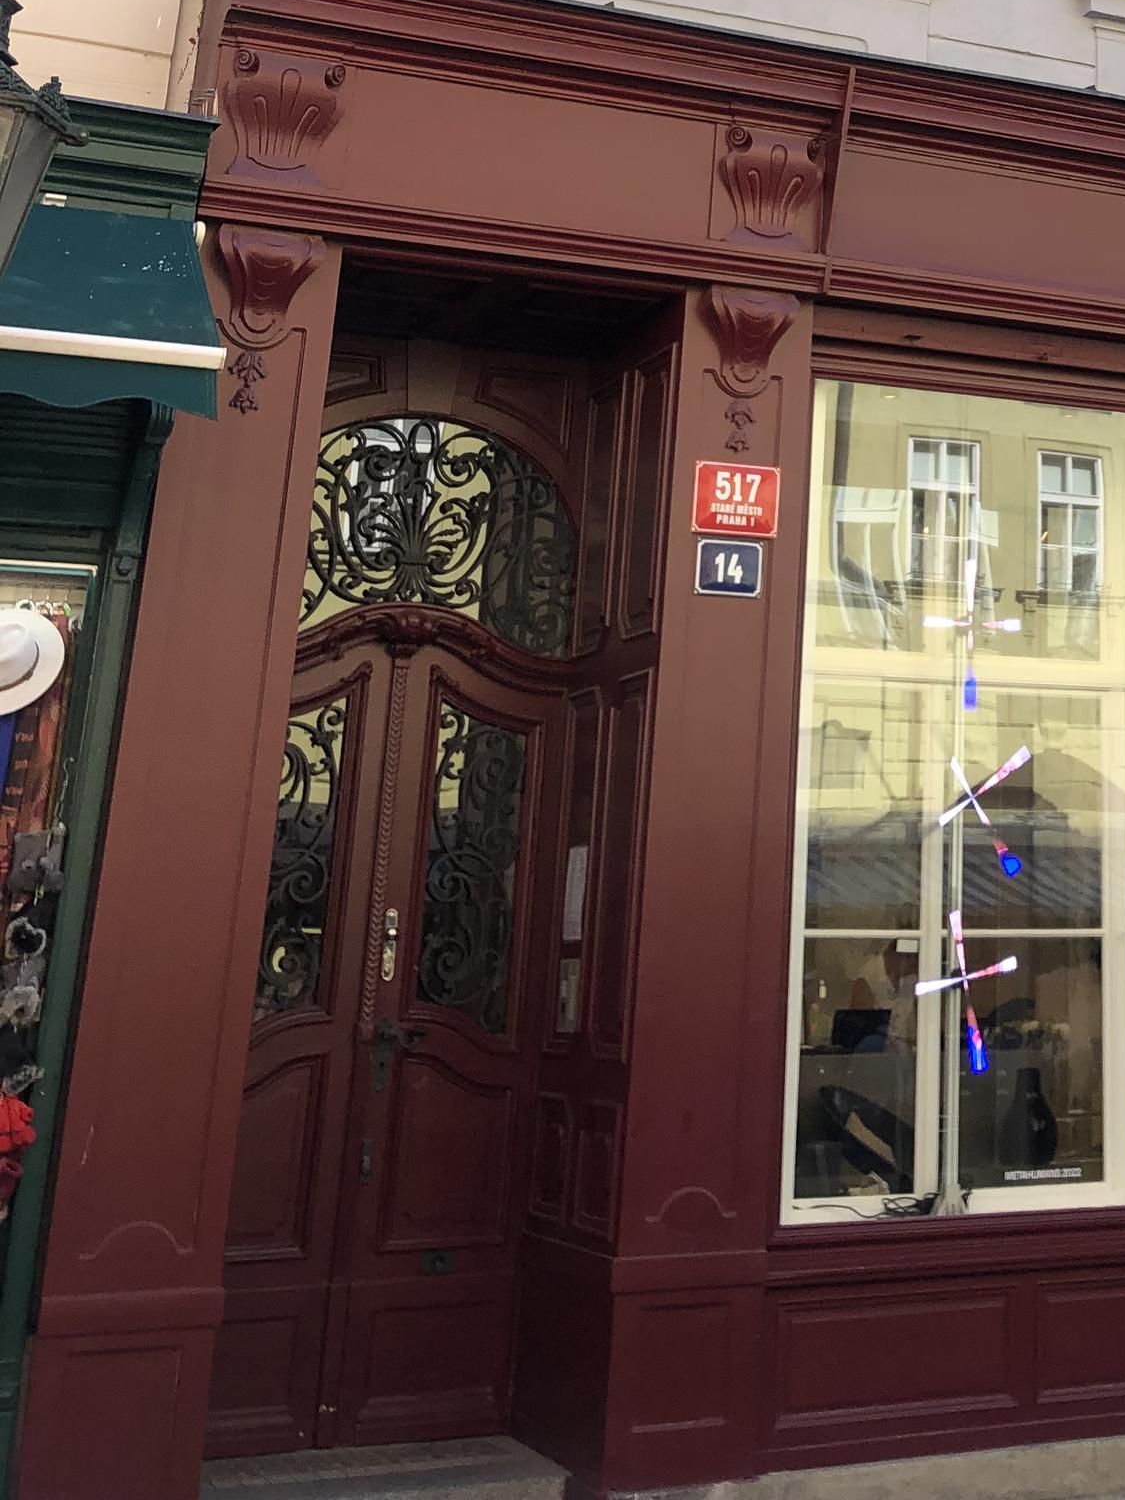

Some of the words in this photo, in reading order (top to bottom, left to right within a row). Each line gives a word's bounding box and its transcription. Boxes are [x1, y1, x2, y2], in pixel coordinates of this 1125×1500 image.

[715, 471, 761, 503] 517
[711, 502, 736, 514] STARÉ
[716, 514, 747, 526] PRAHA
[750, 517, 755, 527] 1
[715, 553, 743, 584] 14
